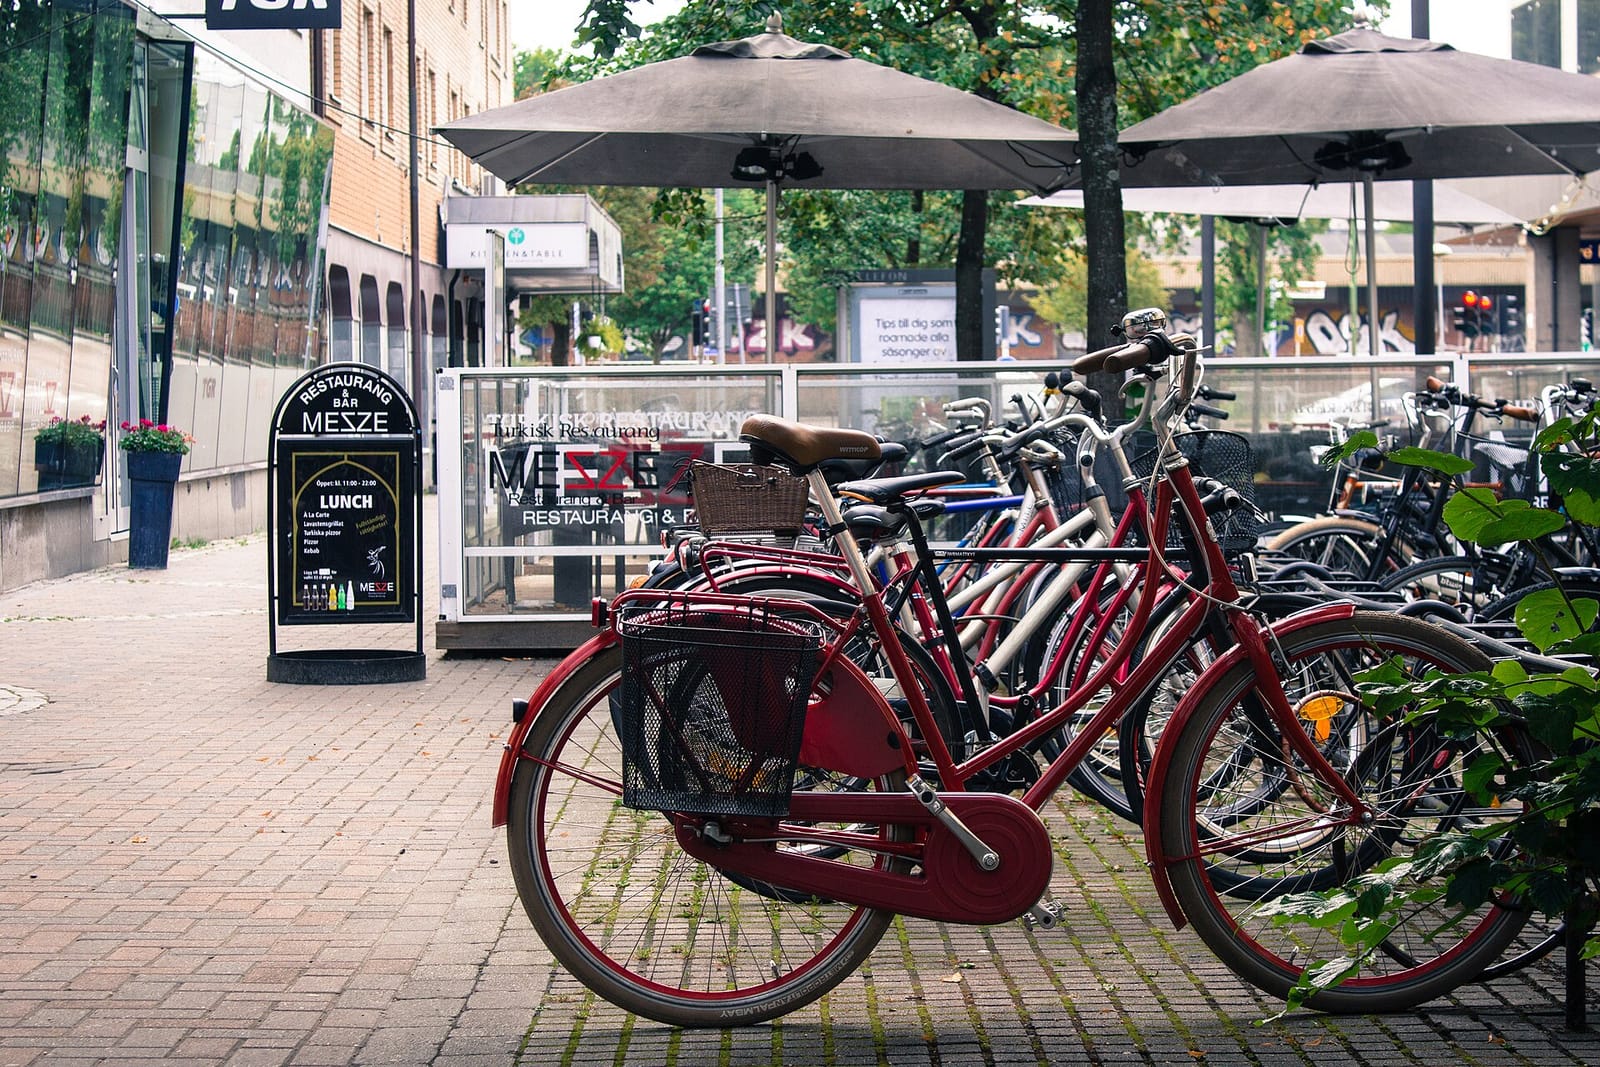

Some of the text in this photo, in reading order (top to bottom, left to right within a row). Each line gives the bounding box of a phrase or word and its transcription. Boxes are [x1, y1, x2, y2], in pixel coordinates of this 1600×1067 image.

[470, 249, 563, 257] KITEN&TABLE
[875, 318, 953, 330] Tips till dig som
[930, 332, 949, 342] alla
[300, 375, 393, 405] RESTAURANG
[342, 389, 349, 397] &
[333, 398, 358, 408] BAR
[560, 423, 660, 442] Resaurang
[320, 495, 373, 509] LUNCH
[662, 509, 676, 524] &
